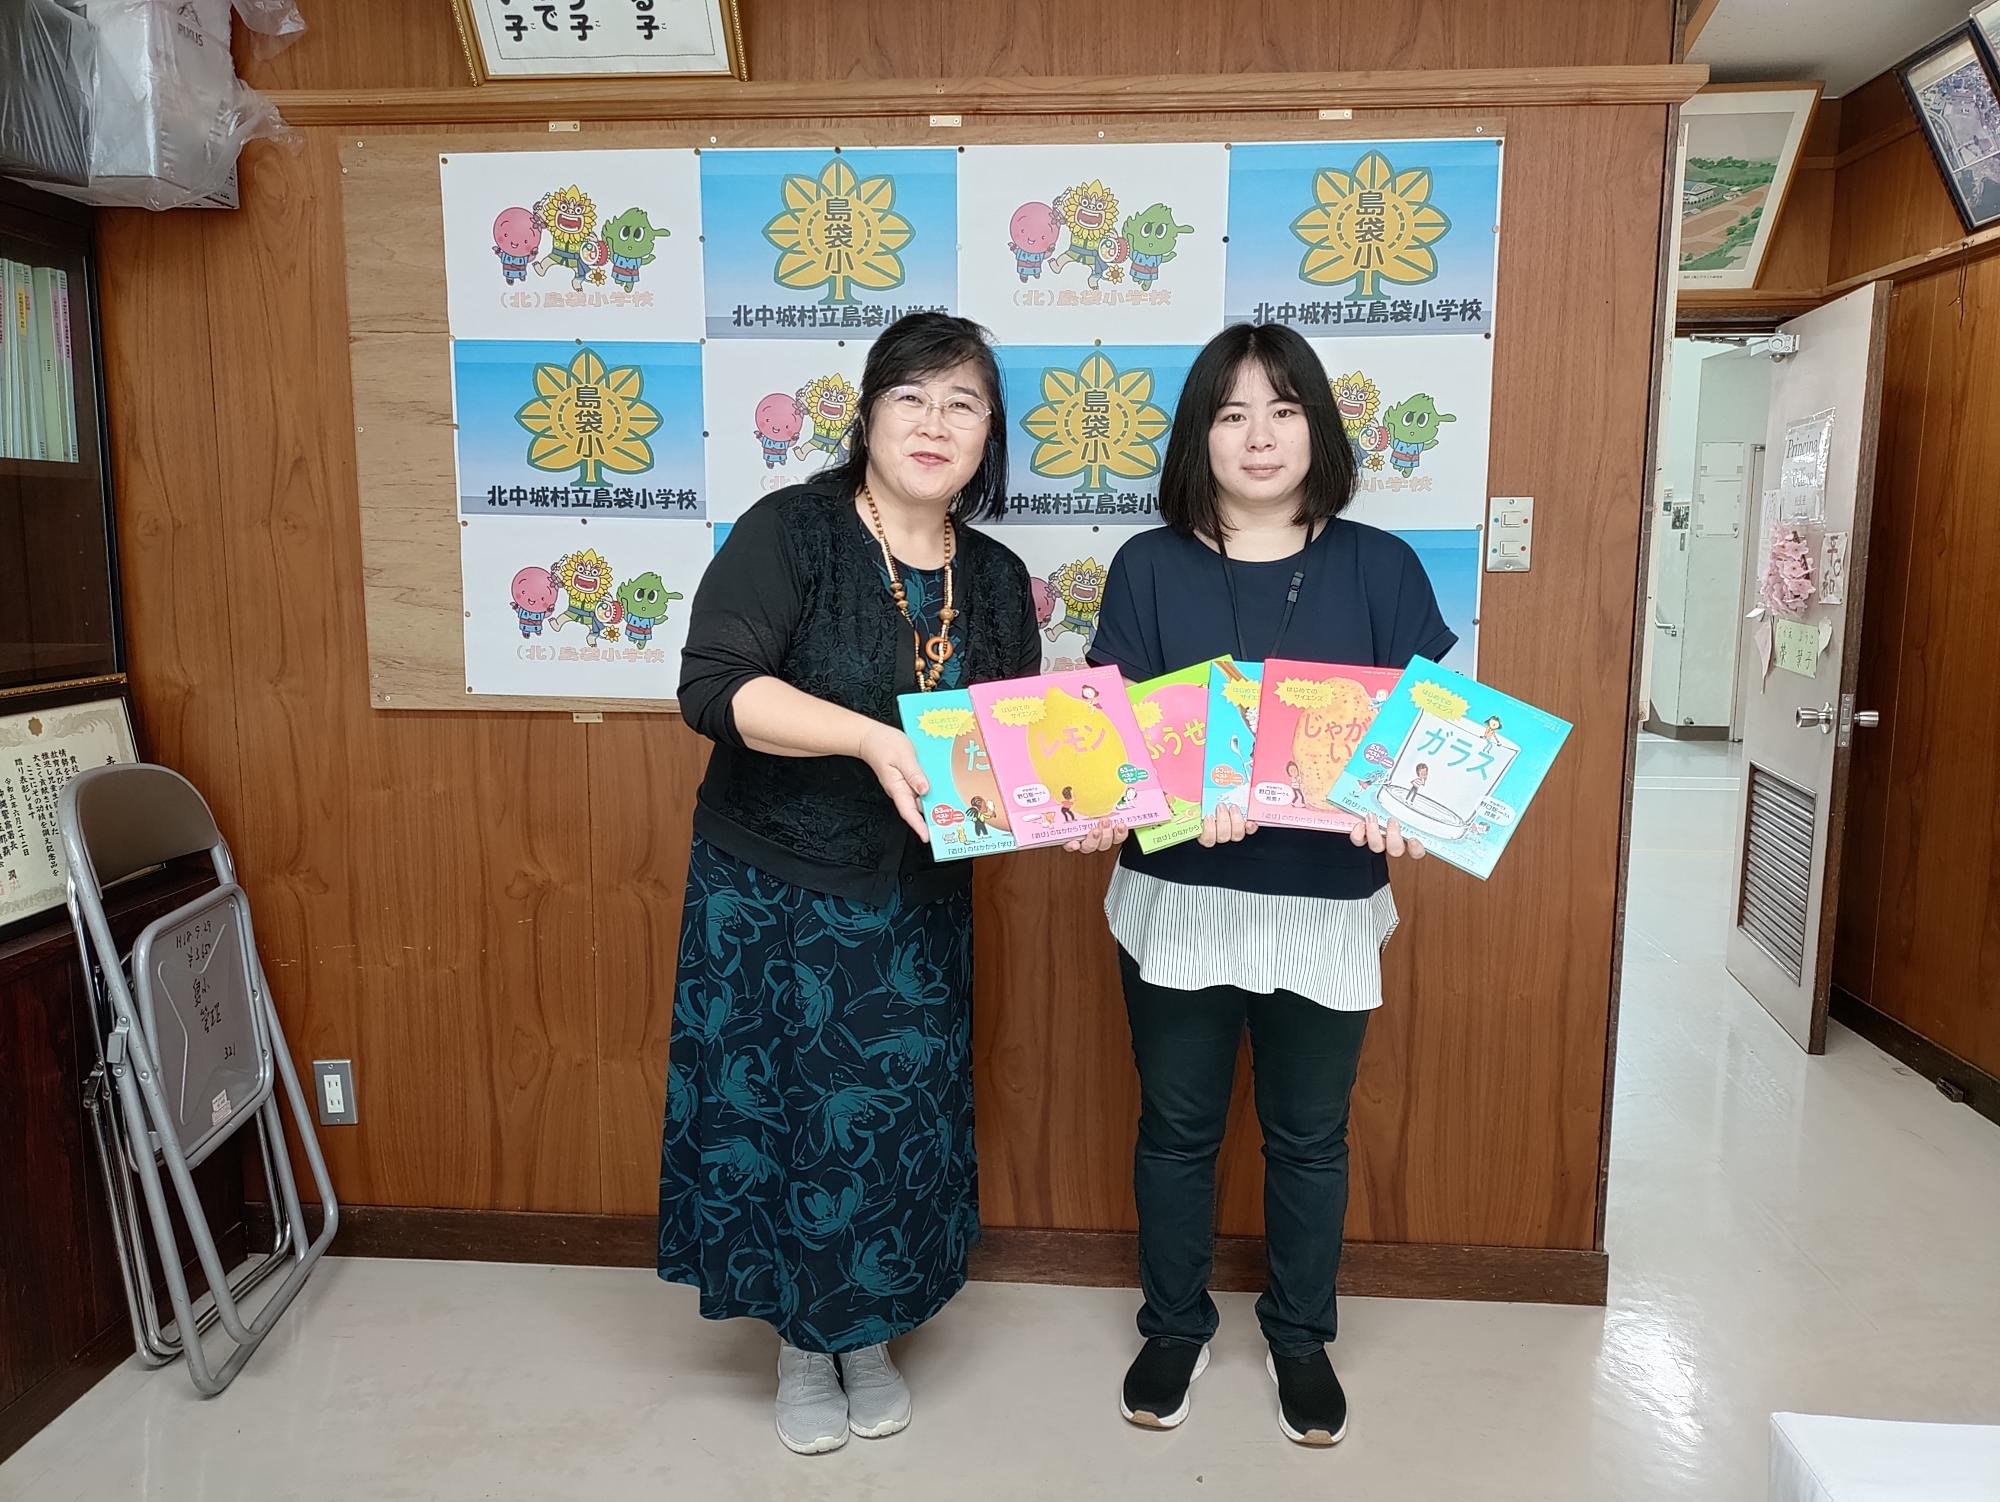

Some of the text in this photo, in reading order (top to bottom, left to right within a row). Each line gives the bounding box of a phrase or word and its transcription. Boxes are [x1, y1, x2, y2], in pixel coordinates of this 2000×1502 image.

[823, 197, 854, 274] 島袋小
[1354, 190, 1386, 270] 島袋小
[1253, 298, 1482, 325] 北中城村立島袋小学校
[573, 384, 605, 458] 島袋小
[1080, 389, 1112, 464] 島袋小
[487, 485, 698, 510] 北中城村立島袋小学校
[964, 739, 991, 772] た
[1037, 725, 1106, 757] レモン
[1417, 728, 1495, 781] ガラス
